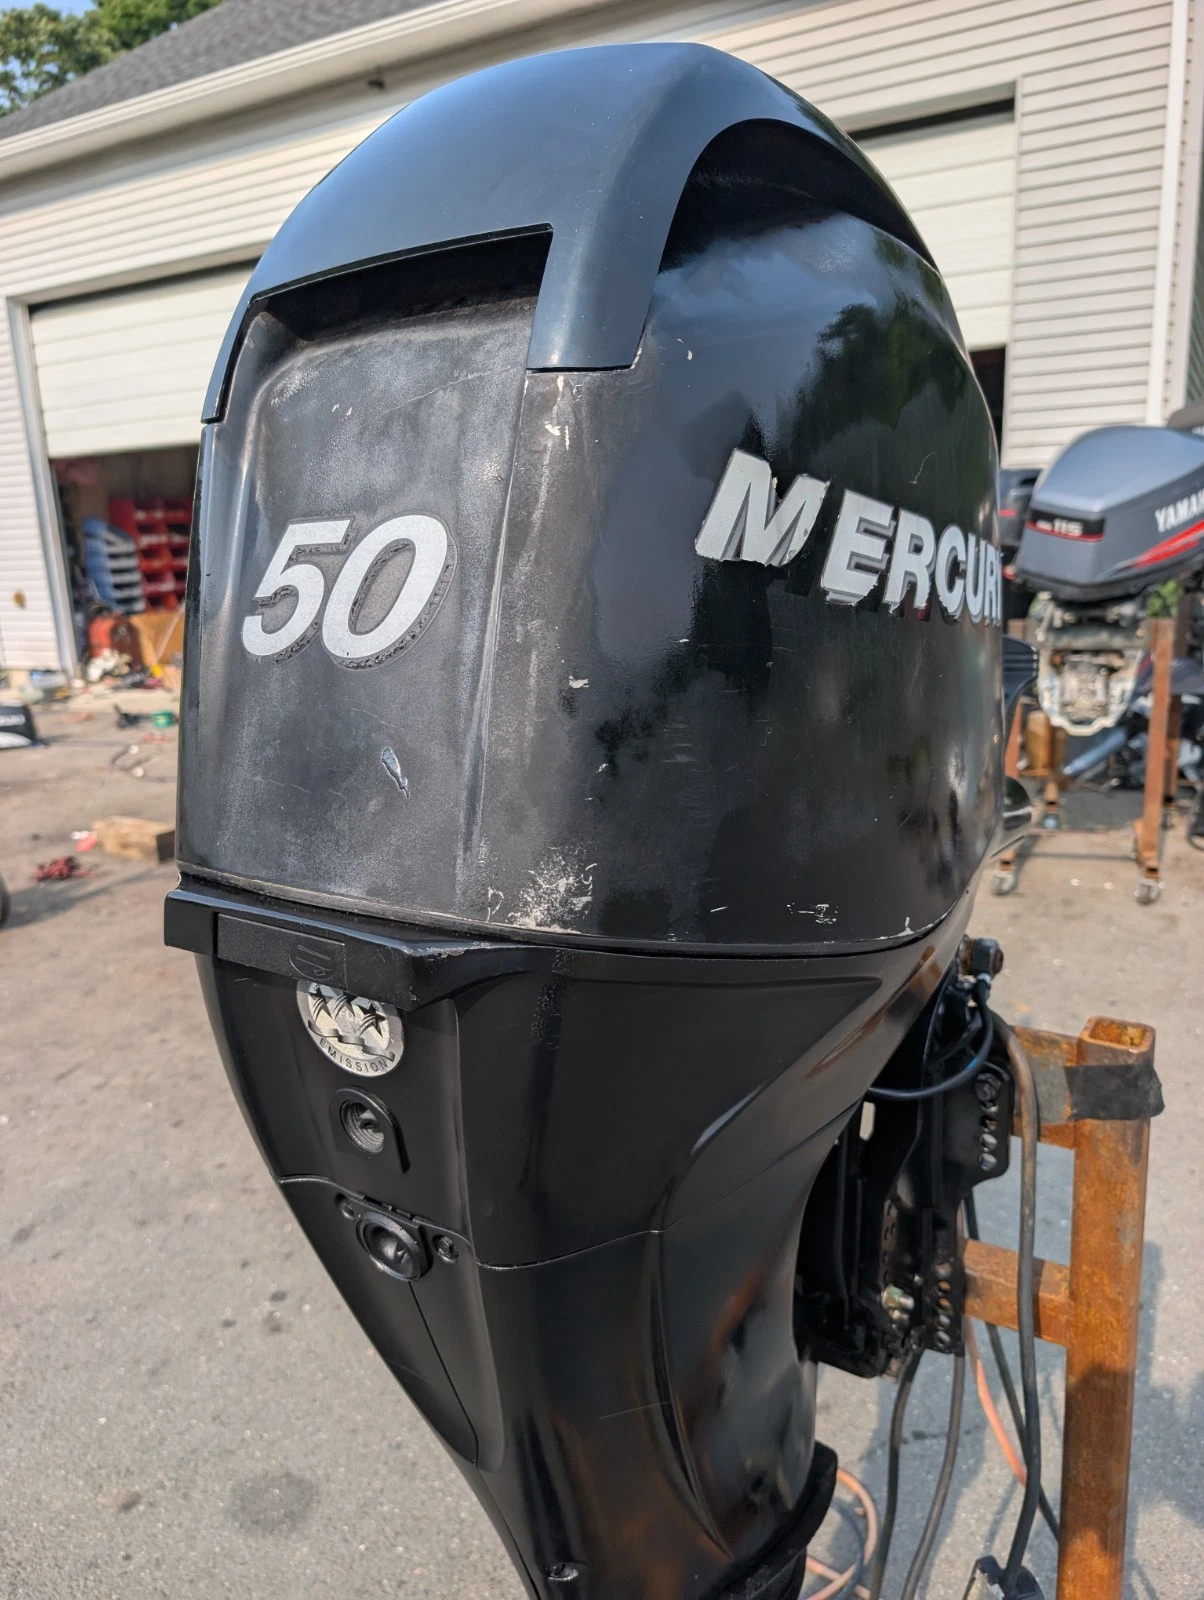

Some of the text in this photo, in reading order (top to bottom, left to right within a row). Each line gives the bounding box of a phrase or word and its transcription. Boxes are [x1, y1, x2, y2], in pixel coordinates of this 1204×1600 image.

[241, 513, 456, 669] 50
[694, 448, 1001, 627] MERCUR
[319, 1037, 389, 1074] EMISSION
